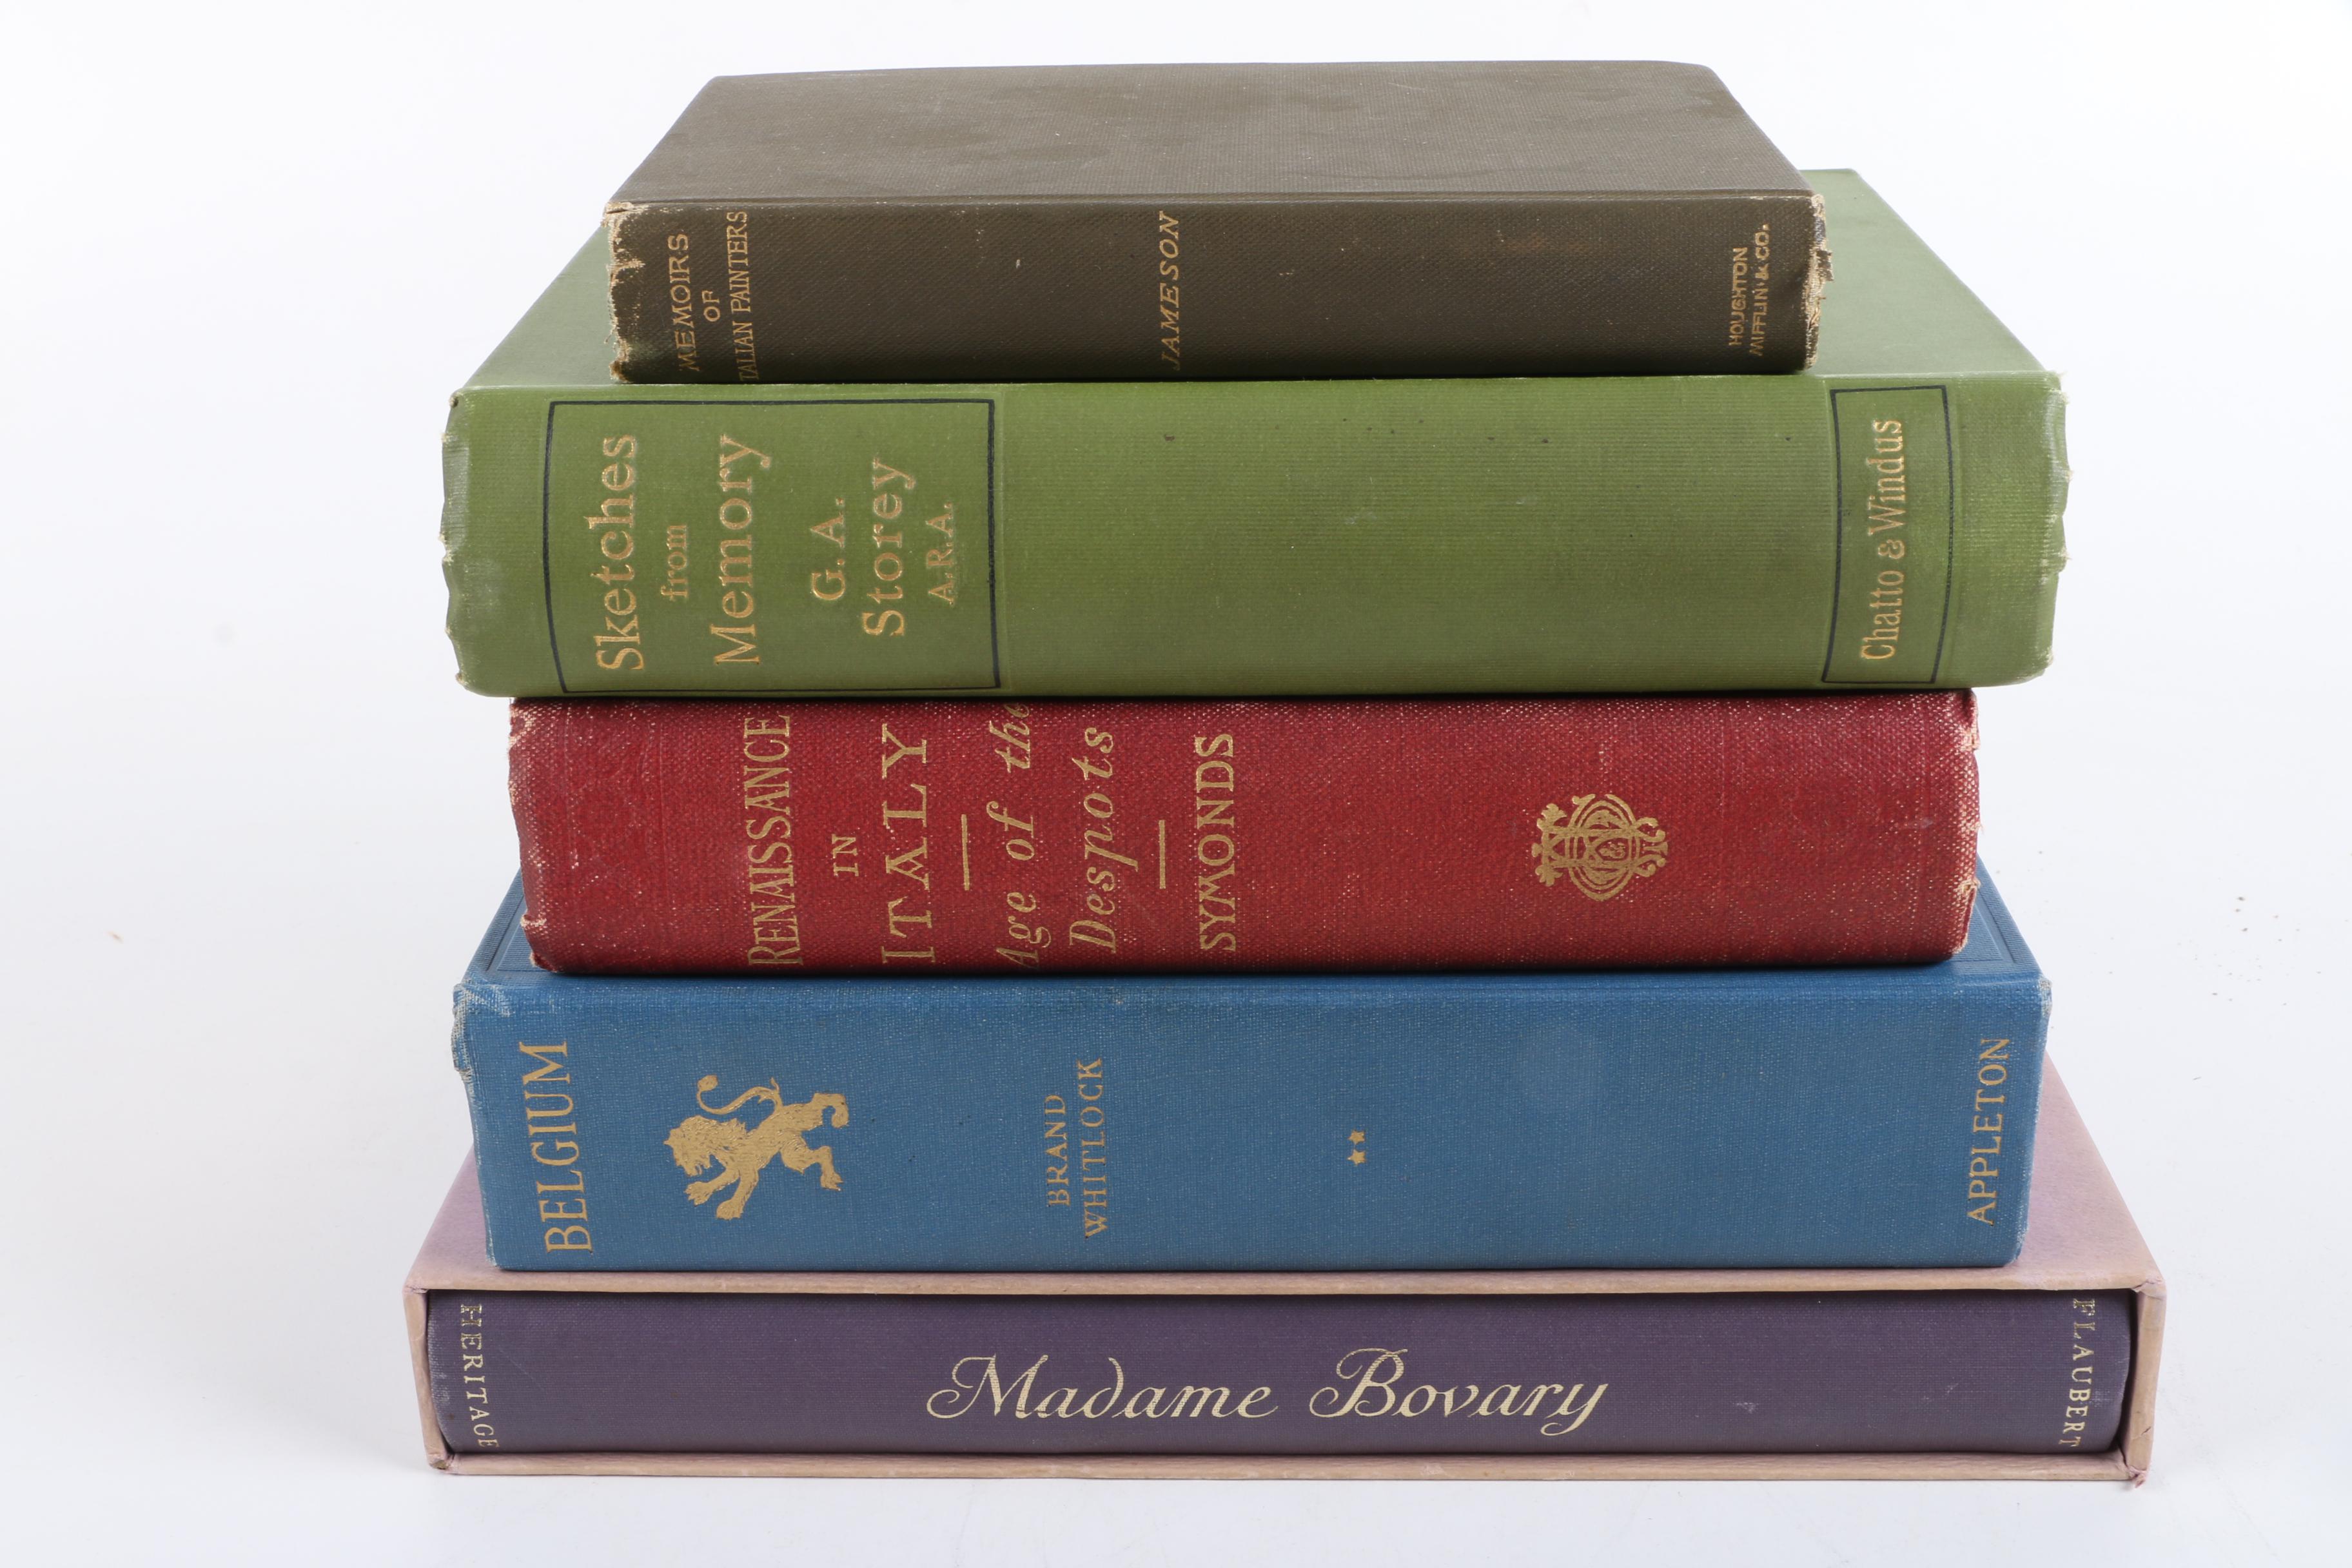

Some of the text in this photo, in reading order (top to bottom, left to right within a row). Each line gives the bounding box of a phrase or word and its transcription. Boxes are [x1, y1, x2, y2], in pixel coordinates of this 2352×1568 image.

[668, 233, 700, 371] MEMOIRS
[702, 289, 720, 322] OF
[727, 211, 759, 381] TALIAN PAINTERS
[1159, 210, 1180, 371] JAMESON
[1729, 247, 1748, 346] HOUGHTON
[1754, 224, 1770, 260] CO.
[1754, 263, 1769, 280] &
[583, 433, 643, 671] Sketches
[660, 524, 689, 602] from
[709, 434, 771, 665] Memory
[810, 498, 847, 601] G. A.
[861, 457, 916, 636] Storey
[925, 501, 956, 605] A.R.A.
[1859, 419, 1906, 661] Chatto & Windus
[743, 715, 803, 966] RENAISSANCE
[832, 834, 859, 877] IN
[881, 723, 936, 963] ITALY
[986, 801, 1035, 861] of
[1068, 727, 1139, 954] Despots
[1195, 734, 1236, 952] SYMONDS
[995, 892, 1052, 969] Age
[518, 1040, 593, 1253] BELGIUM
[1044, 1094, 1071, 1207] BRAND
[1076, 1057, 1109, 1240] WHITLOCK
[1967, 1039, 2011, 1226] APPLETON
[460, 1304, 500, 1447] HERITAGE
[926, 1348, 1609, 1436] Madame Bovary
[2058, 1298, 2095, 1447] FLAUBERT
